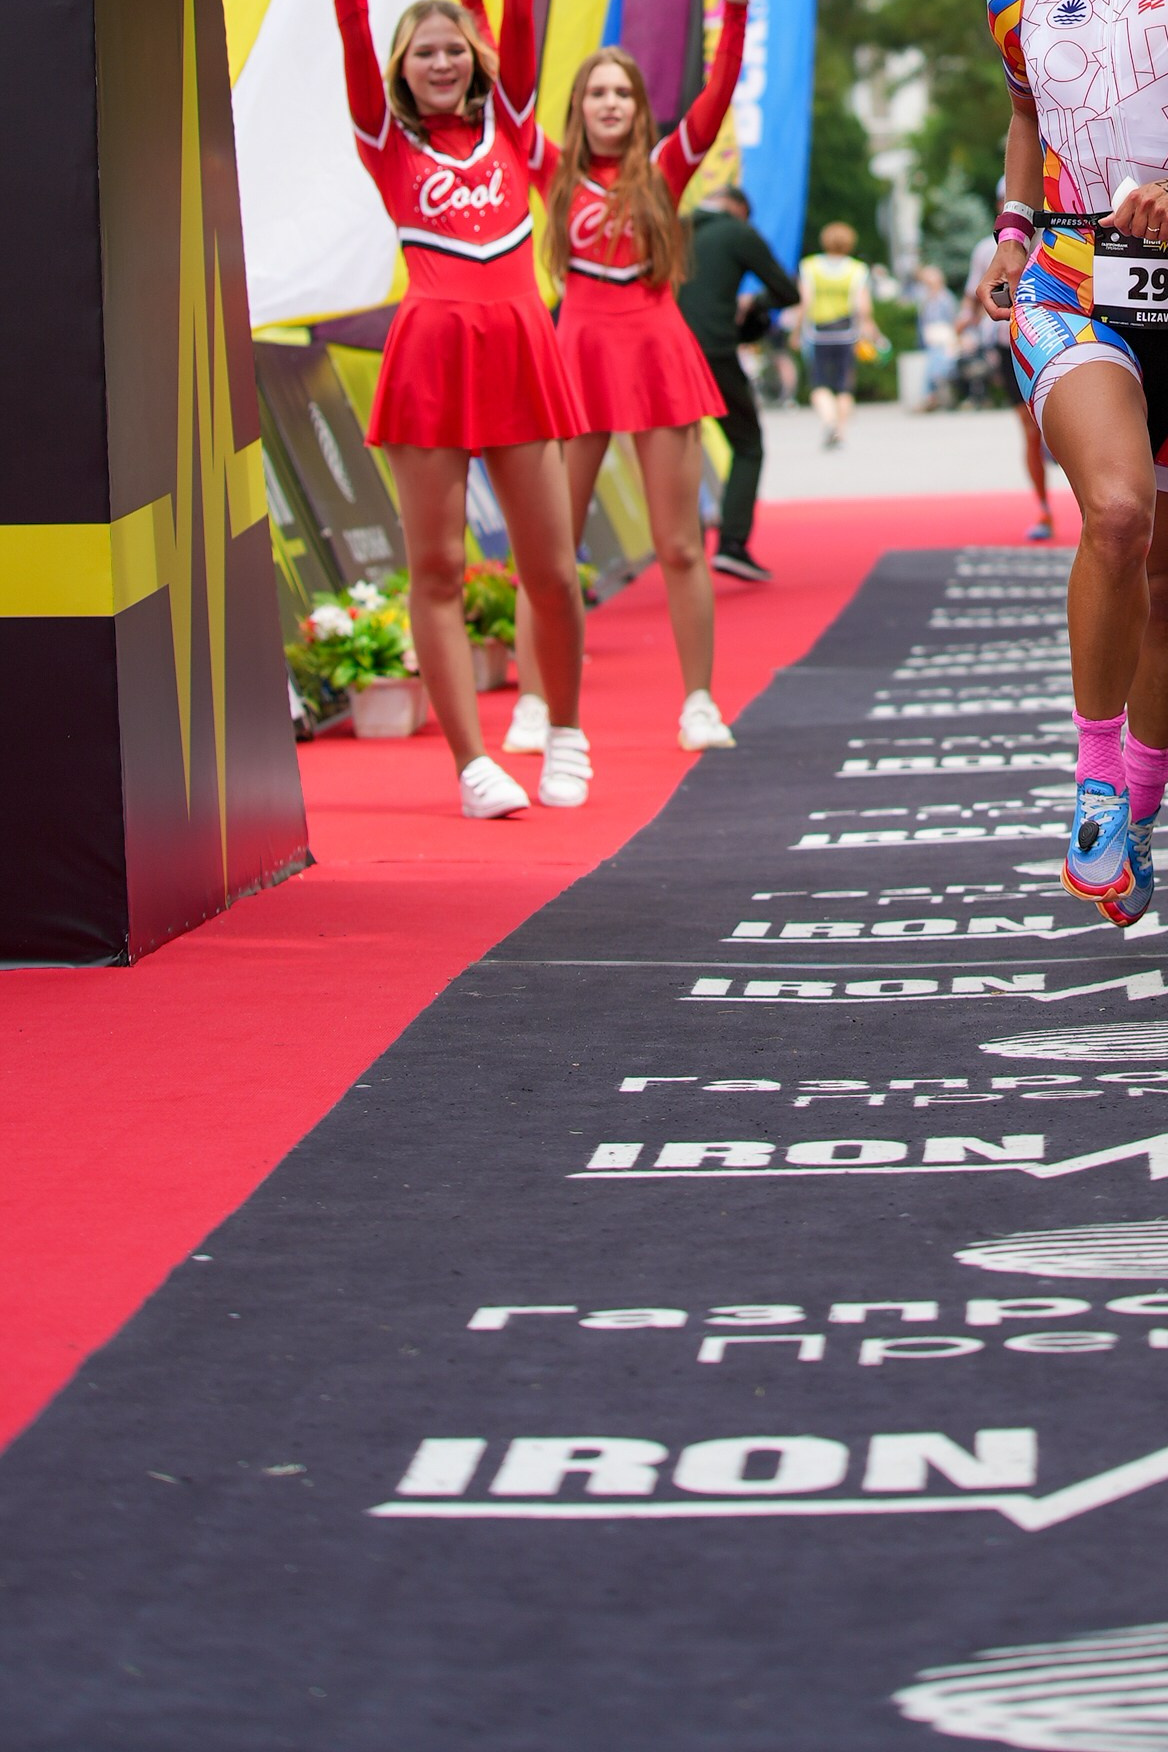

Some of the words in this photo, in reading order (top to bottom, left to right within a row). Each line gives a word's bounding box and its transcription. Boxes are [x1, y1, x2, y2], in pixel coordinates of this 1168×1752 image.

[419, 167, 504, 217] Cool
[731, 915, 1055, 938] IRON
[690, 973, 1048, 997] IRON
[585, 1134, 1045, 1169] IRON
[394, 1427, 1038, 1497] IRON
